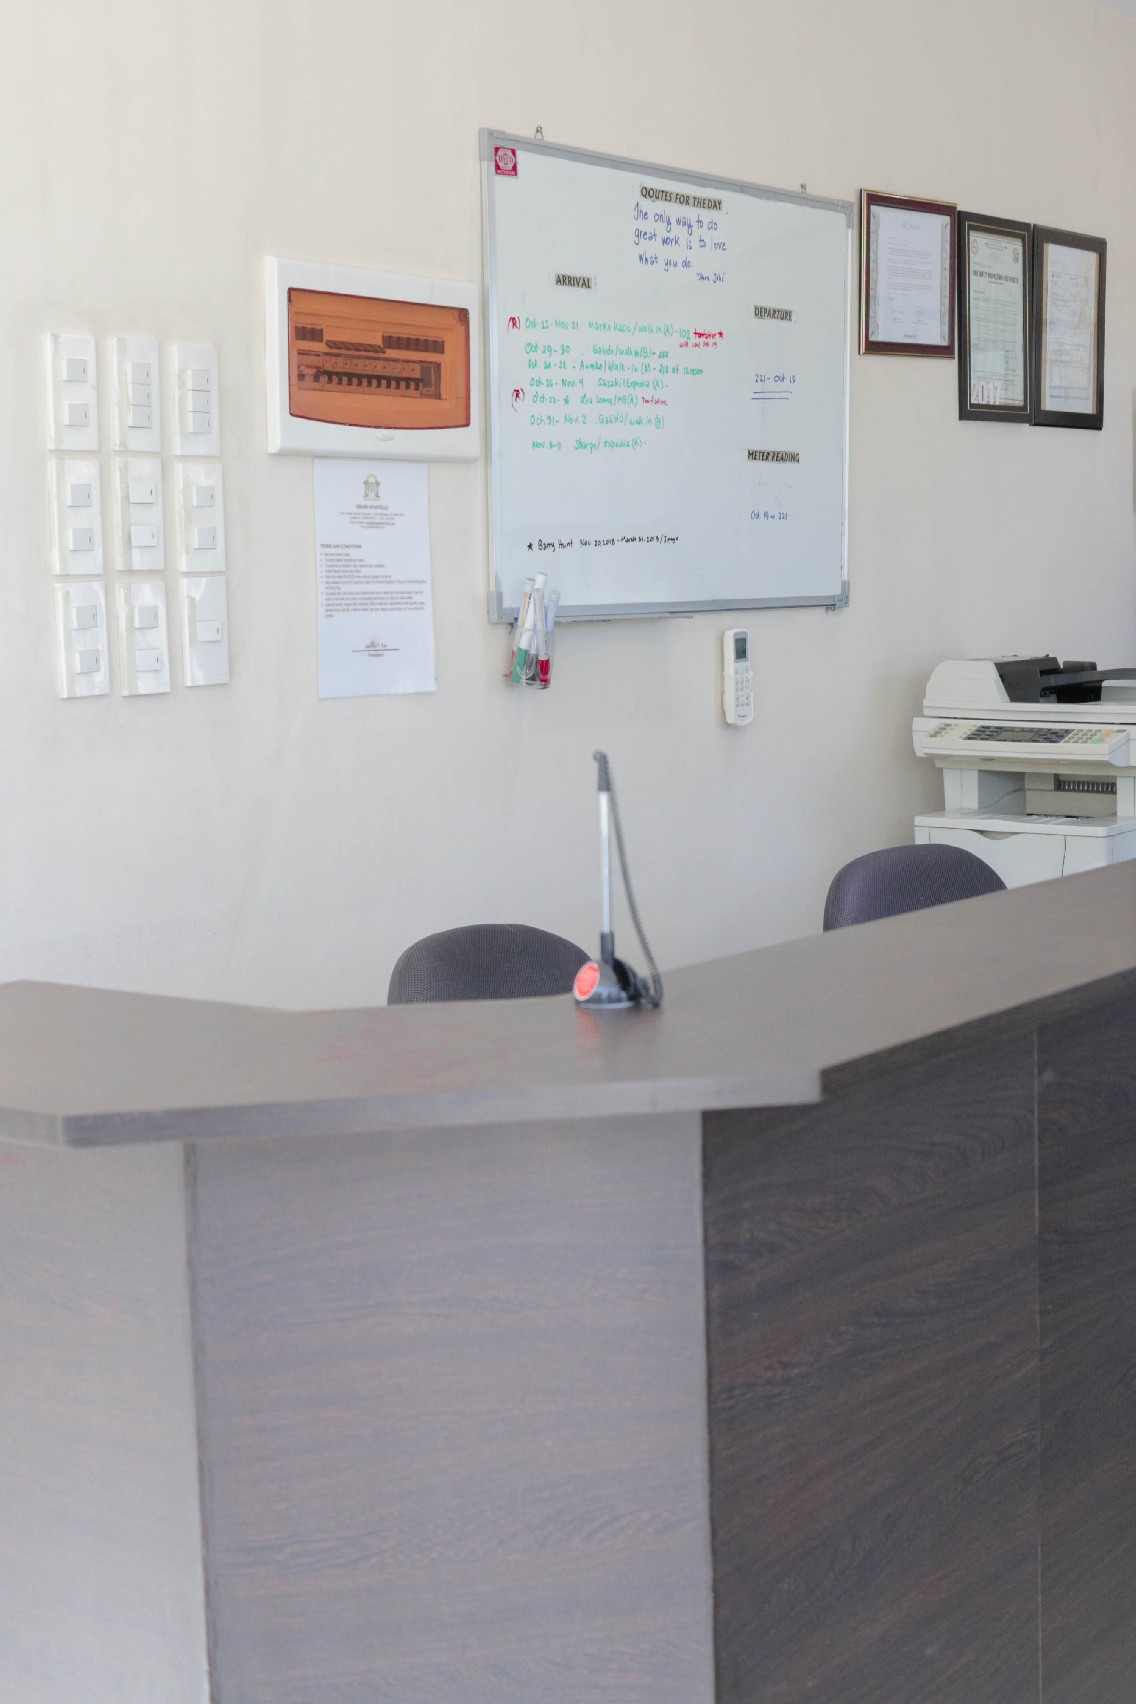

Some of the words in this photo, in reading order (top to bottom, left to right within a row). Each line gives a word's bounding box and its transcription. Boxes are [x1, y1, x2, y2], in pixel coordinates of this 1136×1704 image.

[640, 186, 673, 202] QOUTES
[675, 193, 690, 206] FOR
[661, 234, 681, 247] work
[686, 238, 693, 250] is
[555, 273, 591, 289] ARRIVAL
[753, 305, 793, 322] DEPARTURE
[747, 449, 770, 462] METER
[771, 450, 800, 463] READING
